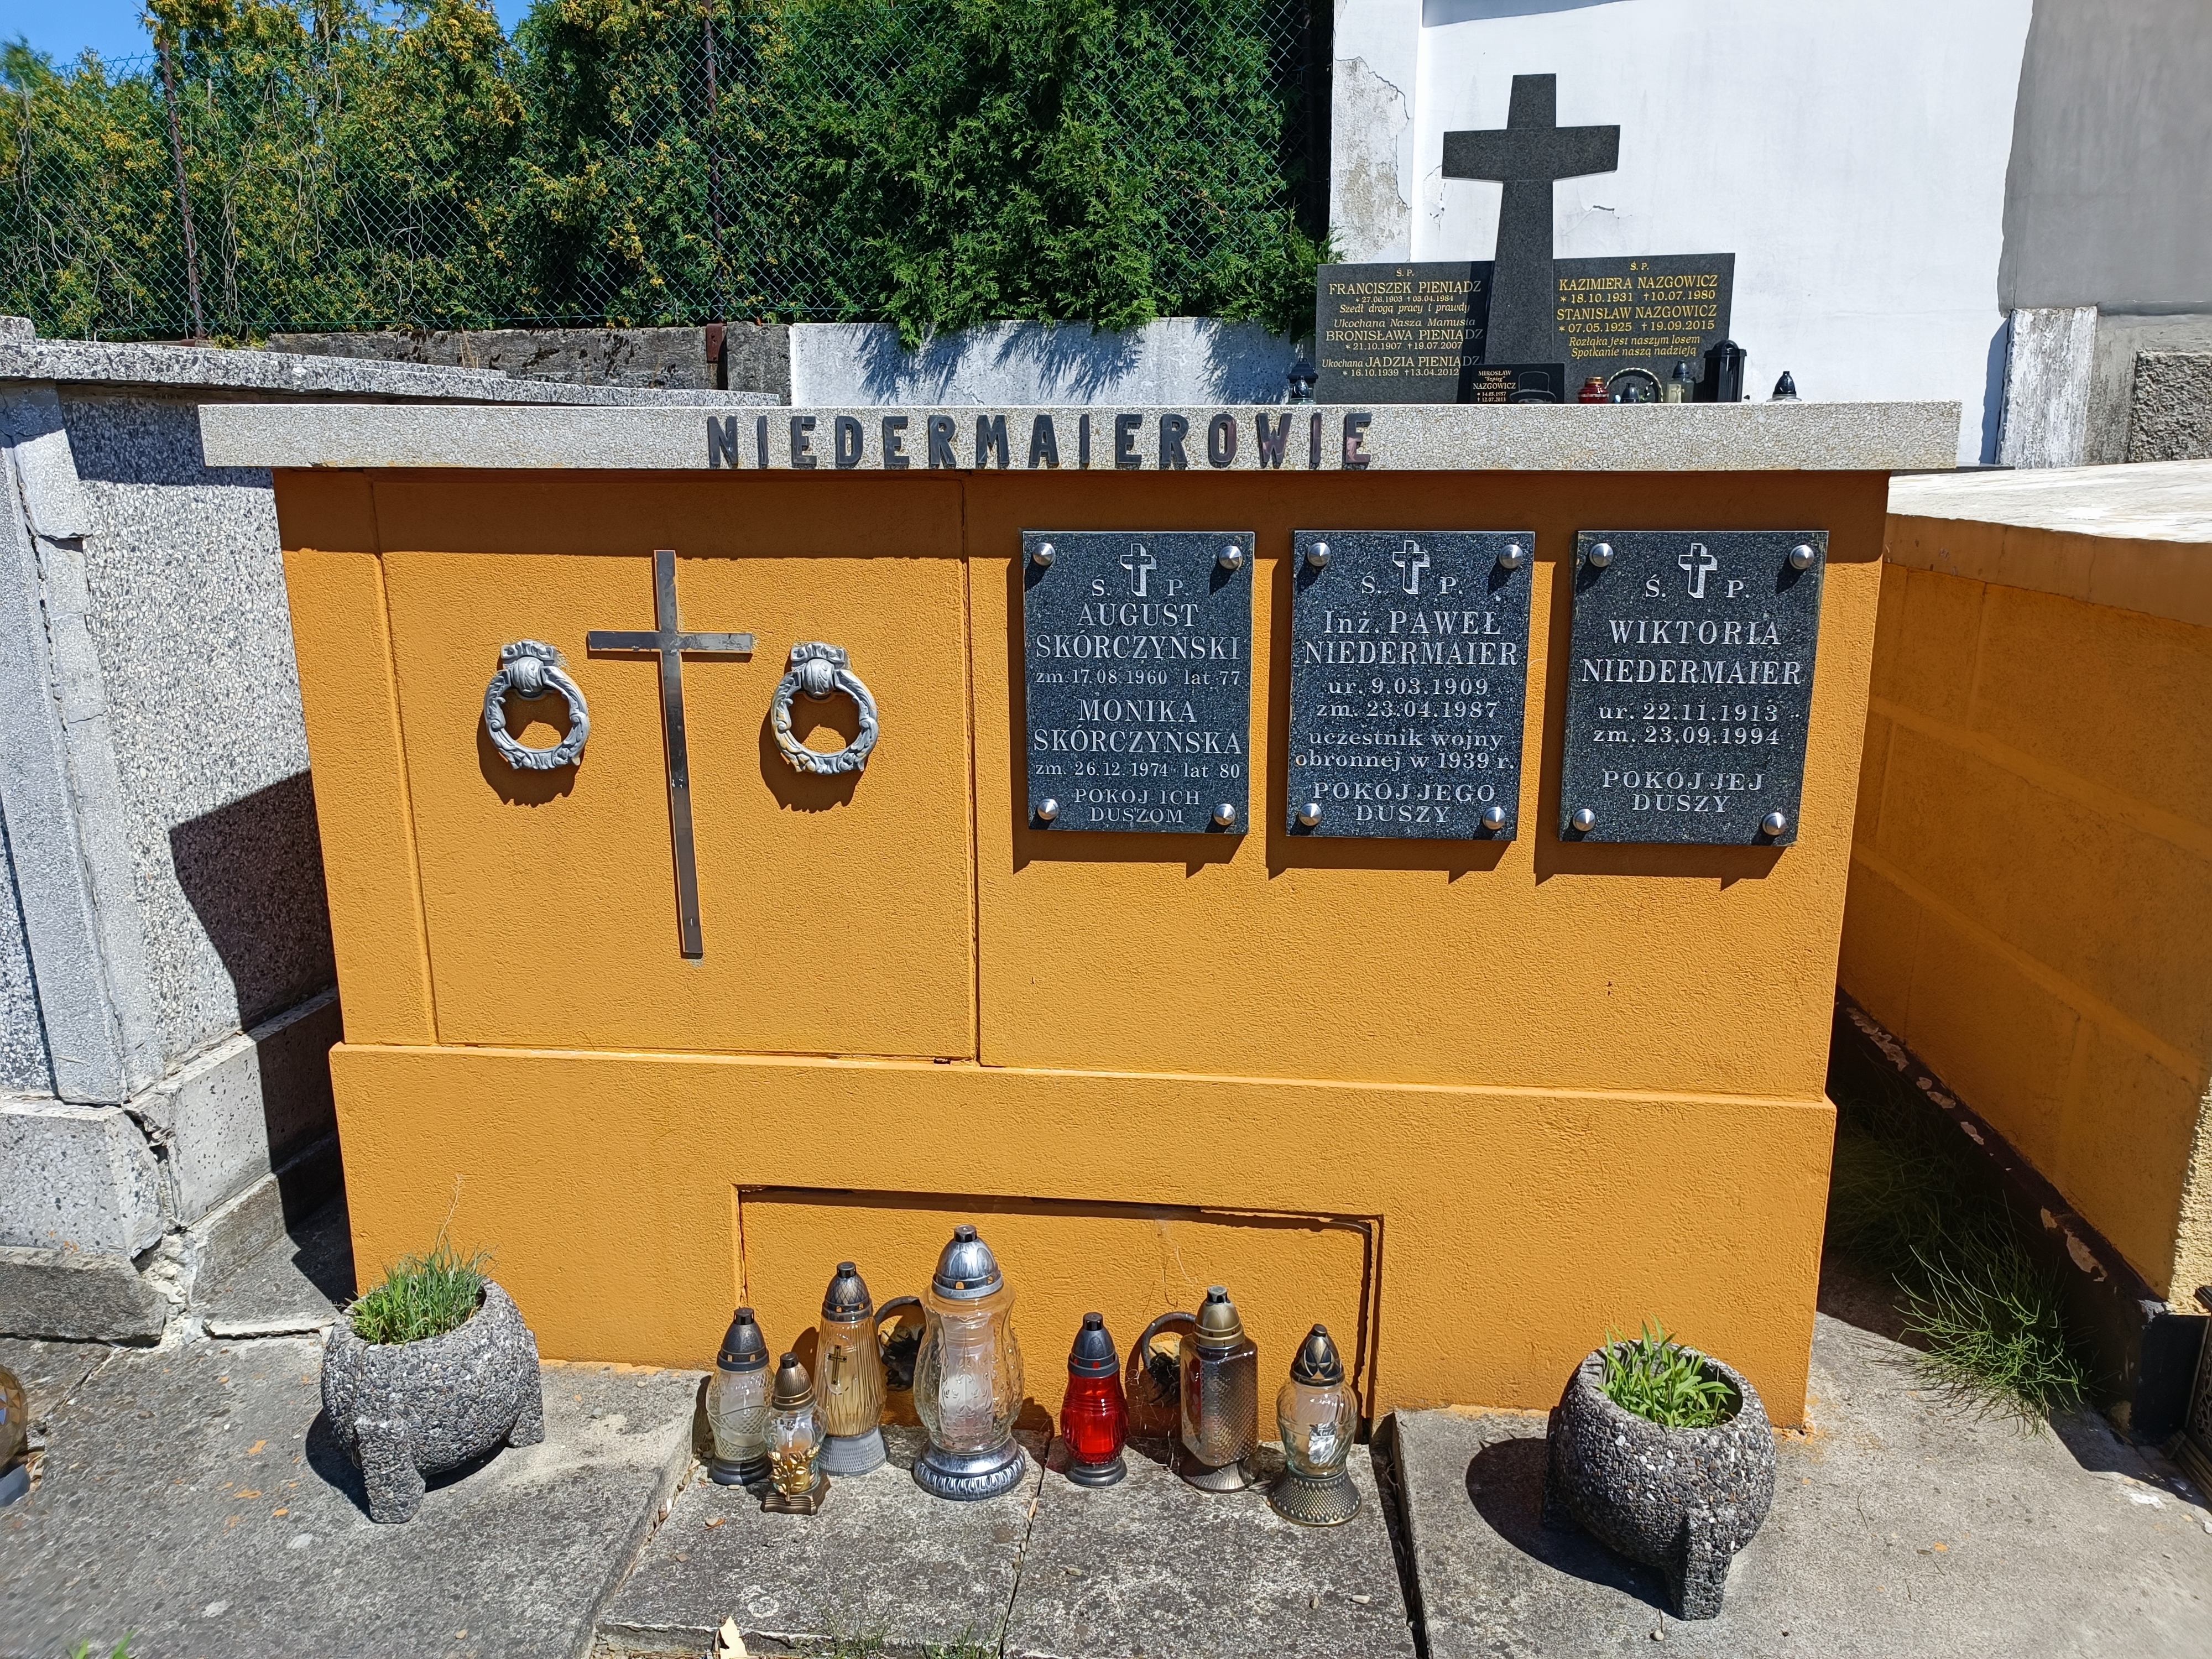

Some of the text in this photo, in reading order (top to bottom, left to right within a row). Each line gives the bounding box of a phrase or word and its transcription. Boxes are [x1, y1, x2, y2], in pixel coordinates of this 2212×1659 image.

[1329, 280, 1481, 295] FRANCISZEK PIENIĄDZ
[1559, 275, 1718, 291] KAZIMIERA NAZGOWICZ
[1571, 290, 1715, 304] 18.10.1931 10.07.1980
[1339, 305, 1364, 313] Szedł
[1369, 305, 1393, 315] drogą
[1398, 306, 1423, 314] pracy
[1435, 303, 1470, 314] prawdy
[1557, 305, 1717, 320] STANISŁAW NAZGOWICZ
[1334, 319, 1385, 327] Ukochana
[1427, 318, 1475, 326] Mamusia
[1568, 320, 1715, 333] 07.05.1925 19.09.2015
[1326, 329, 1484, 341] BRONISŁAWA PIENIĄDZ
[1569, 335, 1700, 347] Rozłąka jest naszym losem
[1414, 341, 1463, 349] 19.07.2007
[1571, 345, 1697, 359] Spotkanie naszą nadzieją
[1322, 356, 1480, 368] Ukochana JADZIA PIENIĄDZ
[1411, 368, 1459, 377] 13.04.2012
[707, 412, 1373, 471] NIEDERMAIEROWIE
[1645, 575, 1750, 598] Ś. P.
[1077, 603, 1199, 627] AUGUST
[1324, 610, 1501, 634] Inż. PAWEŁ
[1609, 620, 1781, 645] WIKTORIA
[1036, 629, 1240, 660] SKÓRCZYŃSKI
[1304, 641, 1518, 665] NIEDERMAIER
[1184, 670, 1210, 685] lat
[1220, 671, 1240, 685] 77
[1582, 659, 1801, 685] NIEDERMAIER
[1328, 678, 1489, 695] ur. 9.03.1909
[1078, 698, 1198, 723] MONIKA
[1316, 701, 1498, 718] zm. 23.04.1987
[1598, 703, 1778, 722] ur. 22.11.1913
[1034, 724, 1243, 754] SKÓRCZYŃSKA
[1309, 728, 1503, 750] uczestnik wojny
[1593, 726, 1780, 745] zm. 23.09.1994
[1295, 749, 1515, 771] obronnej w 1939 r.
[1183, 763, 1209, 778] lat
[1220, 764, 1240, 778] 80
[1602, 768, 1765, 790] POKÓJ JEJ
[1161, 790, 1201, 805] ICH
[1313, 780, 1495, 801] POKÓJ JEGO
[1632, 794, 1730, 813] DUSZY
[1090, 807, 1185, 823] DUSZOM
[1355, 806, 1452, 822] DUSZY
